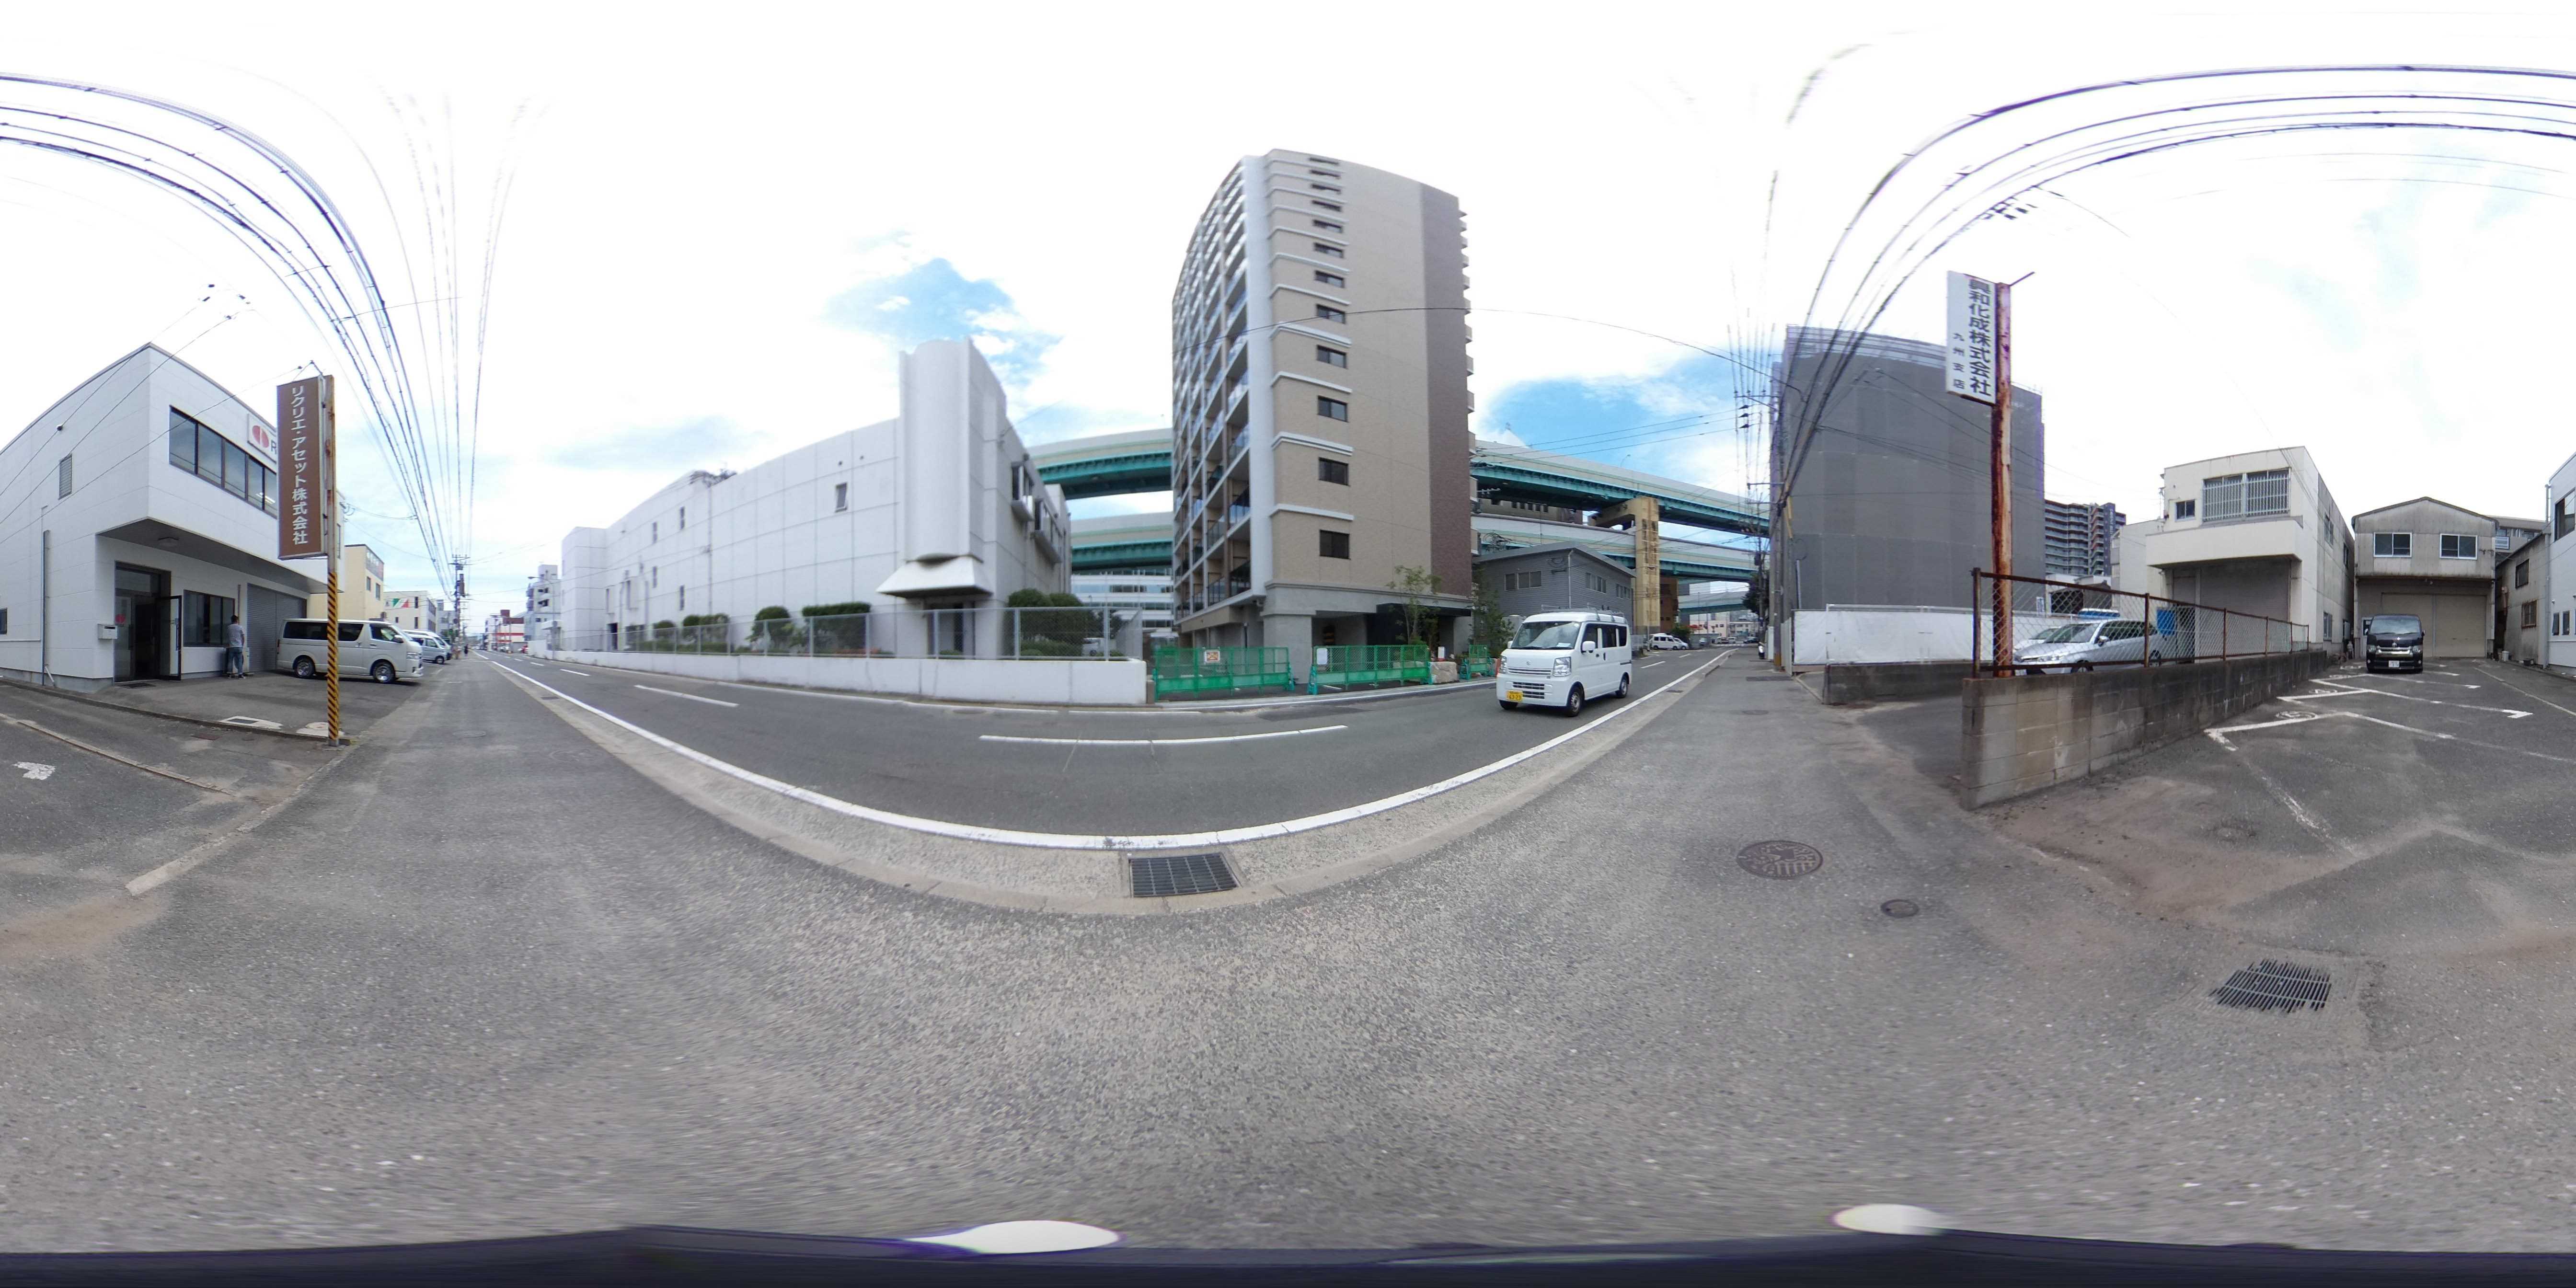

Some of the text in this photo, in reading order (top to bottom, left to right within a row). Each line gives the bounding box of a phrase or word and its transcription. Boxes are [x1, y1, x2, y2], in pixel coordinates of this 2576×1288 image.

[1953, 333, 1965, 389] 九州支店
[290, 385, 309, 545] リクリエ・アセット株式会社
